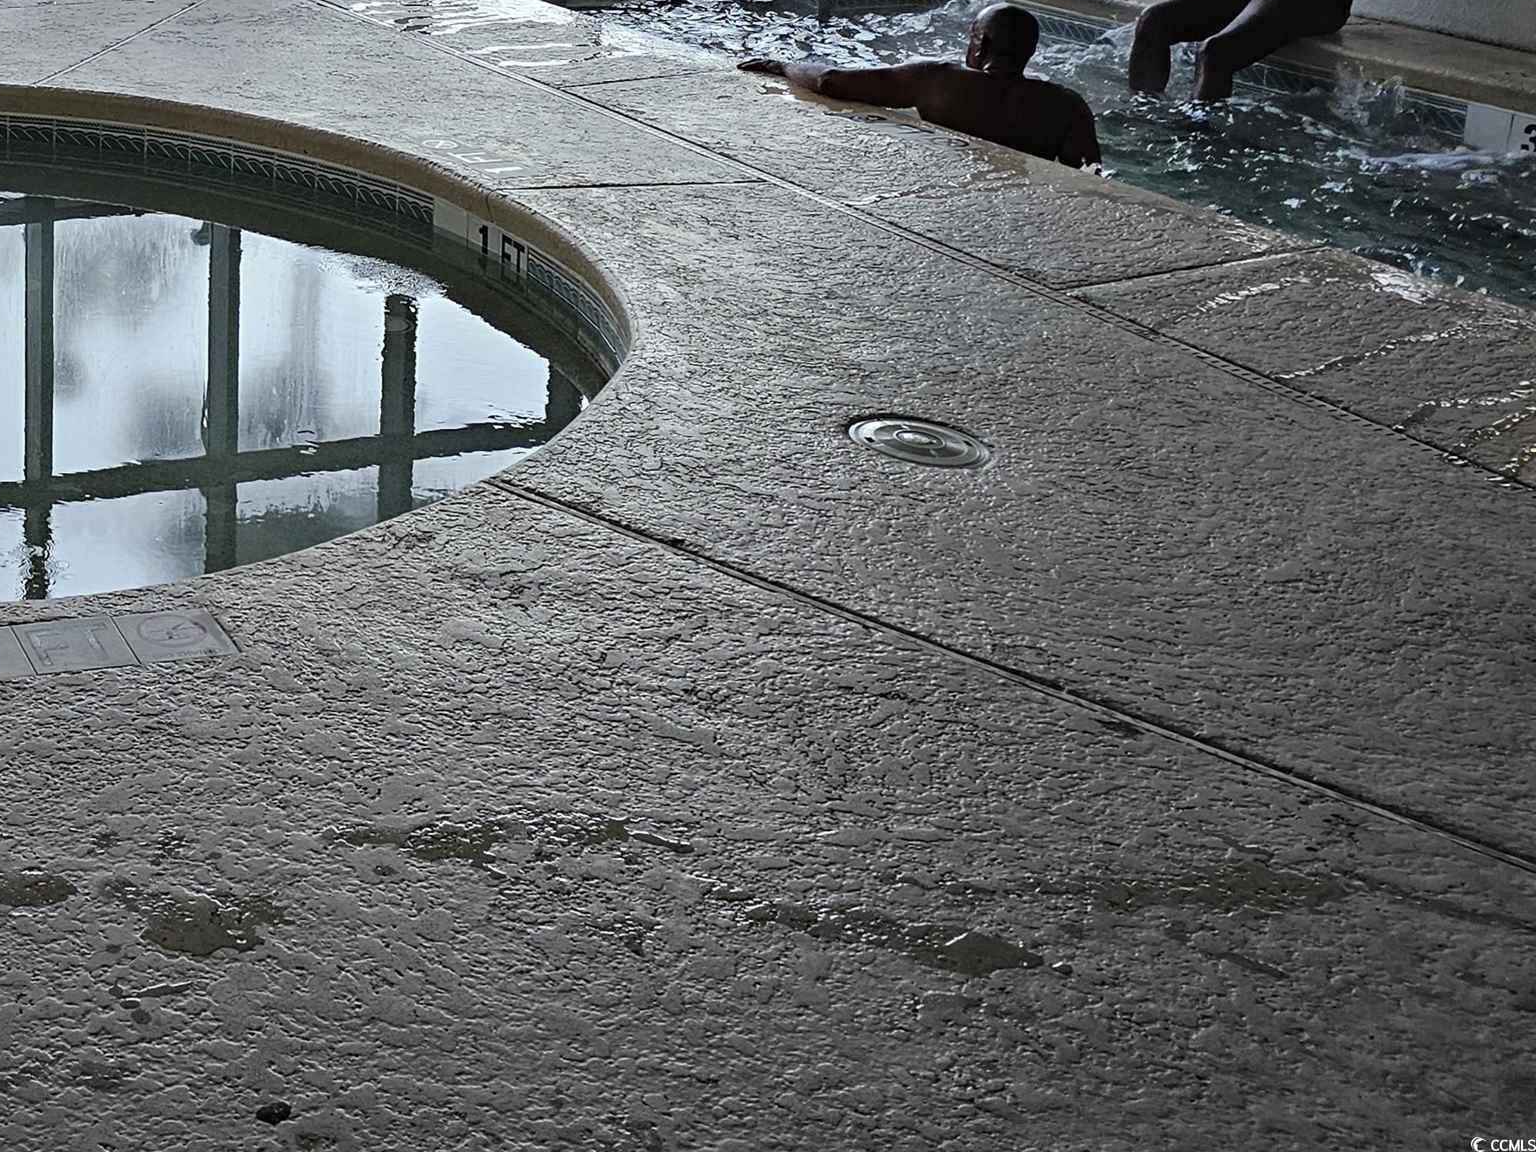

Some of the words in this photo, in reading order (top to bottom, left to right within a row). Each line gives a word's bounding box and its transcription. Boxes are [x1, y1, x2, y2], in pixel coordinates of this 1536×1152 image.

[479, 225, 489, 255] 1
[501, 233, 525, 273] FT
[25, 624, 111, 667] FT
